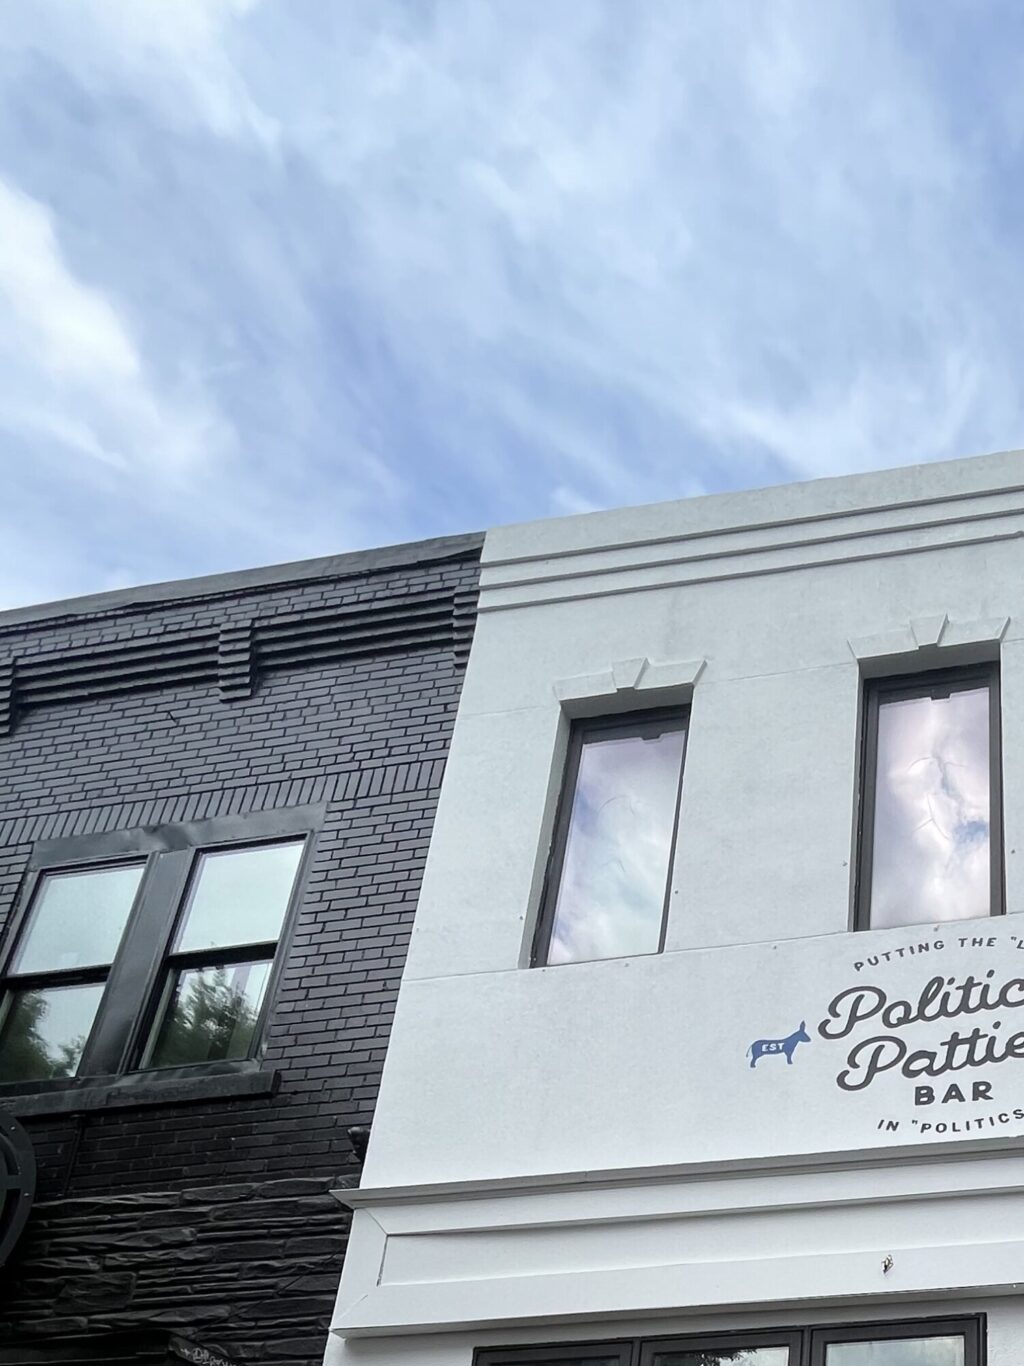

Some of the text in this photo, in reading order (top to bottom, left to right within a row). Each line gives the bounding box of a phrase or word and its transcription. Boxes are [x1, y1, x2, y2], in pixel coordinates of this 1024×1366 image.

[853, 940, 945, 972] PUTTING
[958, 937, 997, 948] THE
[761, 1042, 785, 1052] EST
[914, 1080, 994, 1106] BAR
[877, 1119, 900, 1132] IN
